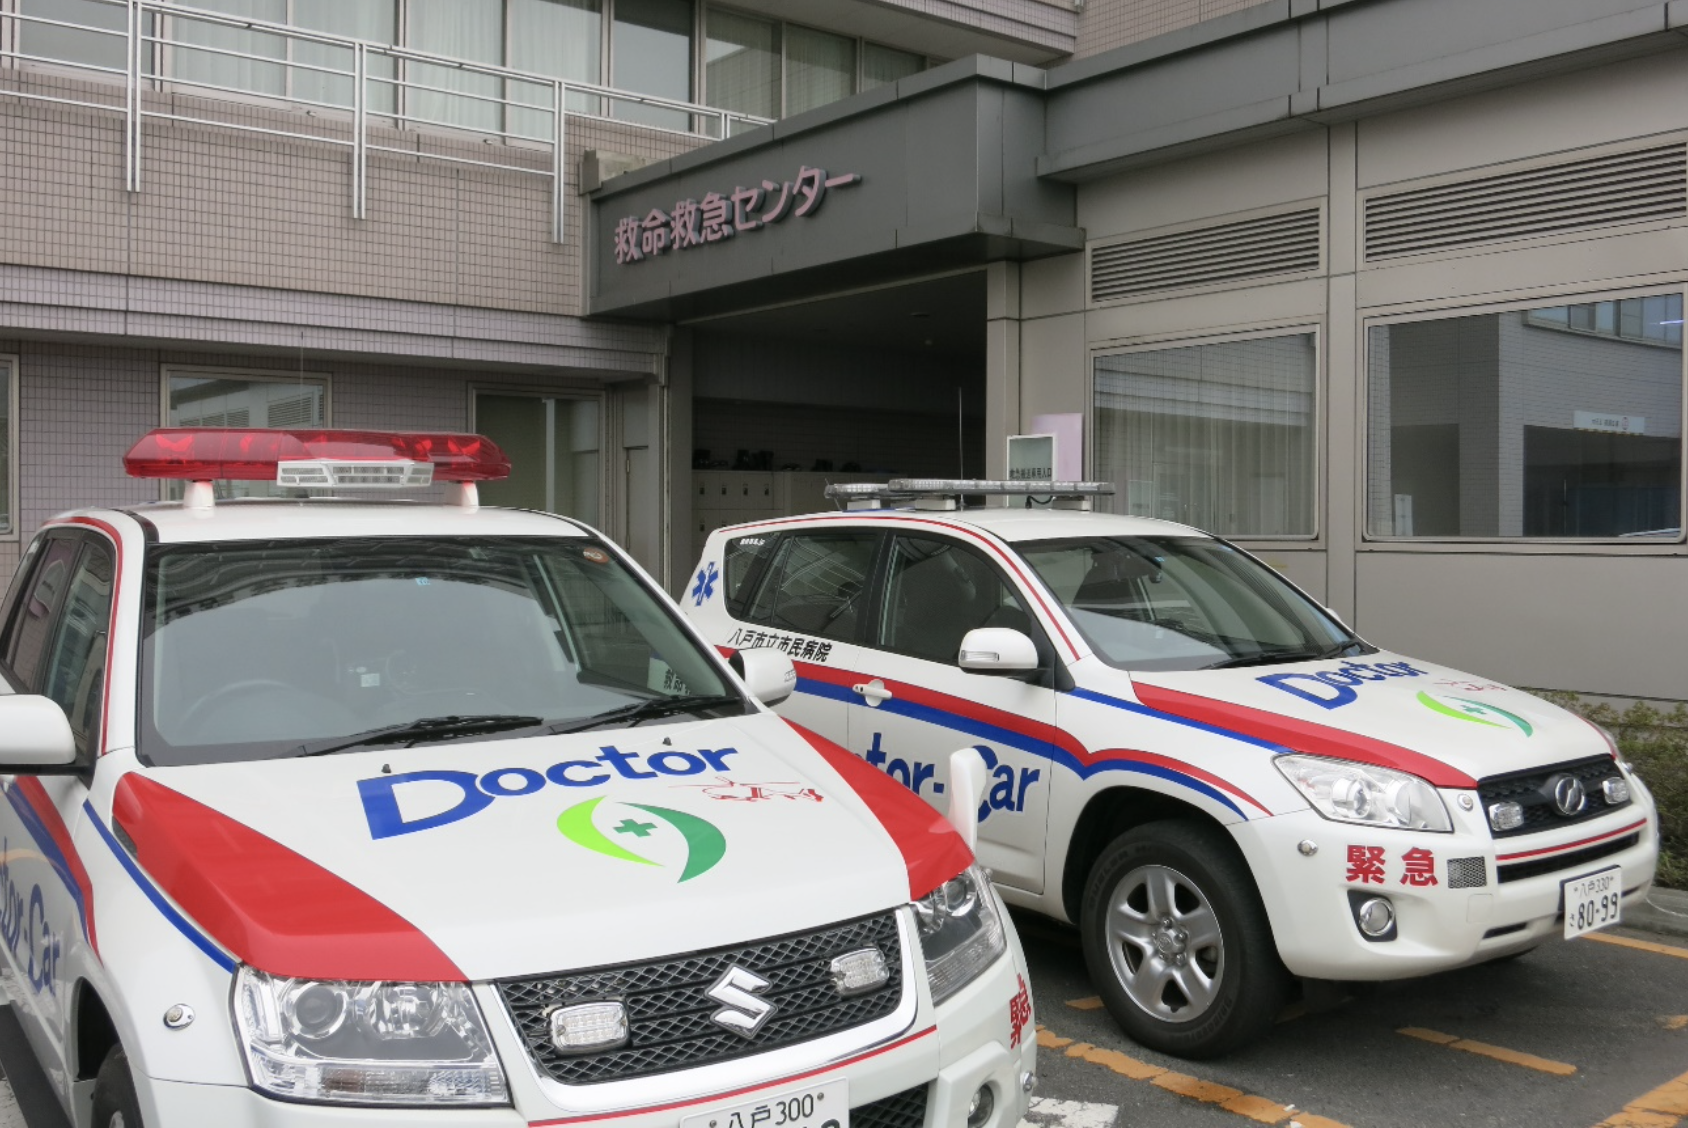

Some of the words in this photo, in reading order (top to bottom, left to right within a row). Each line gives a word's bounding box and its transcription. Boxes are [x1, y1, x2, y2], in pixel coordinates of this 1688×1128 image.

[613, 165, 860, 264] 救命救急センター
[727, 628, 832, 662] 八戸市立市民病院
[1255, 660, 1428, 710] Doctor
[356, 745, 738, 840] Doctor
[1345, 844, 1439, 887] 緊急
[1577, 892, 1618, 930] 80-99
[728, 1093, 814, 1128] 八戸300
